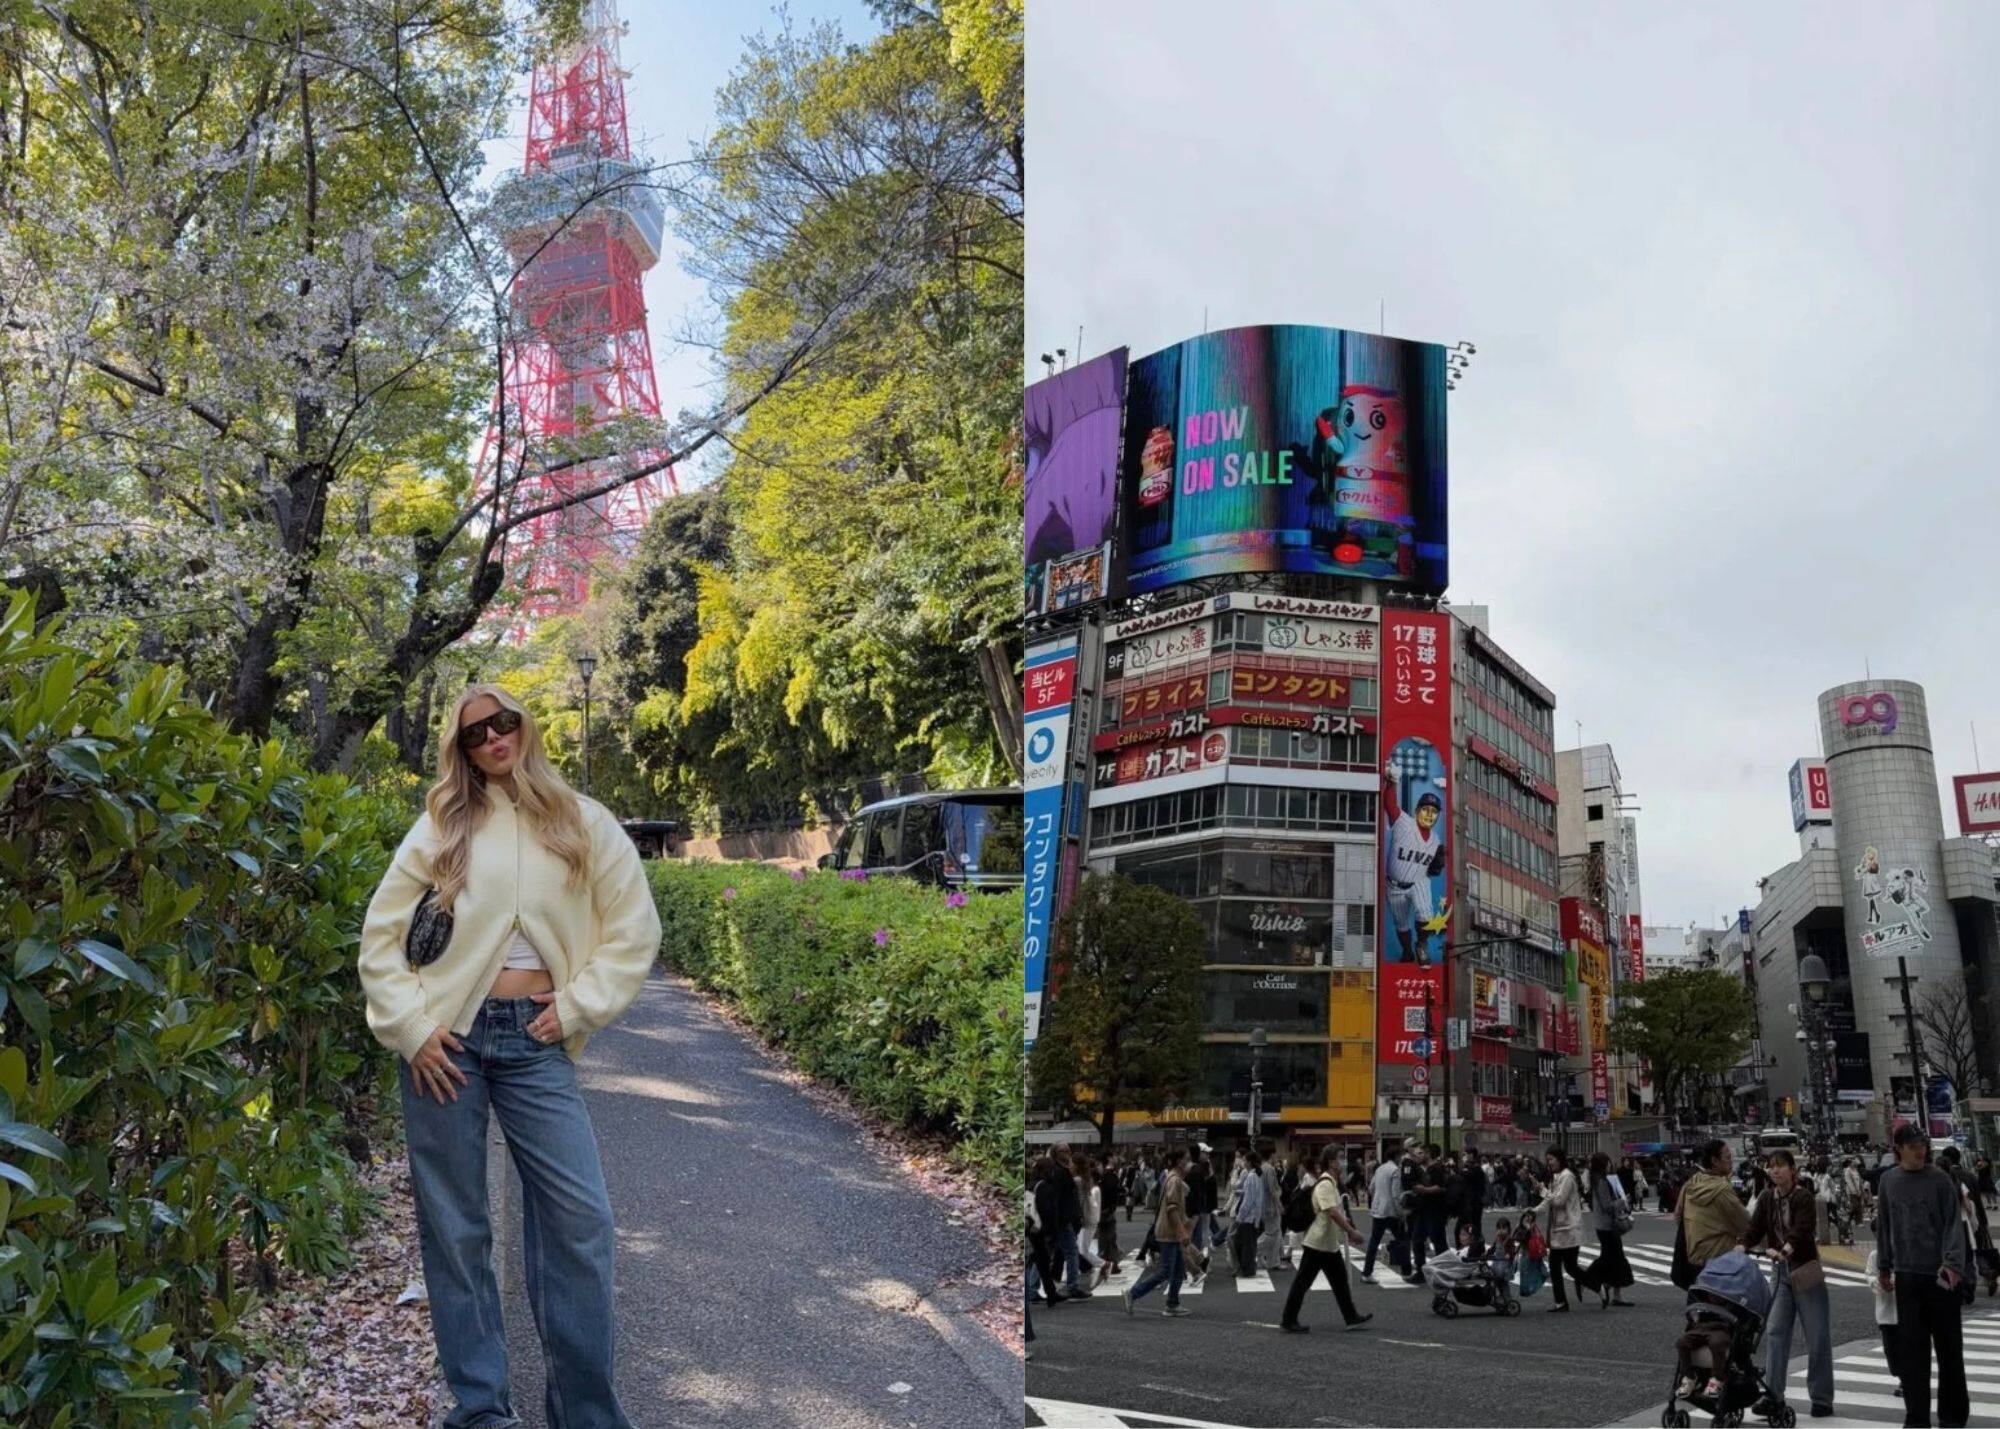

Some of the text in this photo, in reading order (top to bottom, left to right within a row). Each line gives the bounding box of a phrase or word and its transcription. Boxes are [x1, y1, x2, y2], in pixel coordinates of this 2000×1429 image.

[1185, 406, 1249, 450] NOW
[1183, 449, 1294, 496] ON SALE
[1116, 602, 1206, 637] しゃぶしゃぶバイキング
[1254, 595, 1374, 619] しゃぶしゃぶバイキング
[1155, 627, 1206, 658] しゃぶ葉
[1304, 624, 1375, 651] しゃぶ葉
[1108, 652, 1124, 670] 9F
[1417, 626, 1437, 704] 野球って
[1030, 667, 1067, 689] 当ビル
[1234, 671, 1347, 700] コンタクト
[1037, 686, 1057, 705] 5F
[1168, 712, 1211, 739] ガスト
[1311, 713, 1364, 736] ガスト
[1098, 762, 1117, 781] 7F
[1144, 746, 1197, 780] ガスト
[1812, 772, 1827, 806] UQ
[1024, 813, 1052, 958] コンタクトの
[1398, 989, 1436, 999] 叶えよ。
[1395, 1040, 1438, 1054] 17LE
